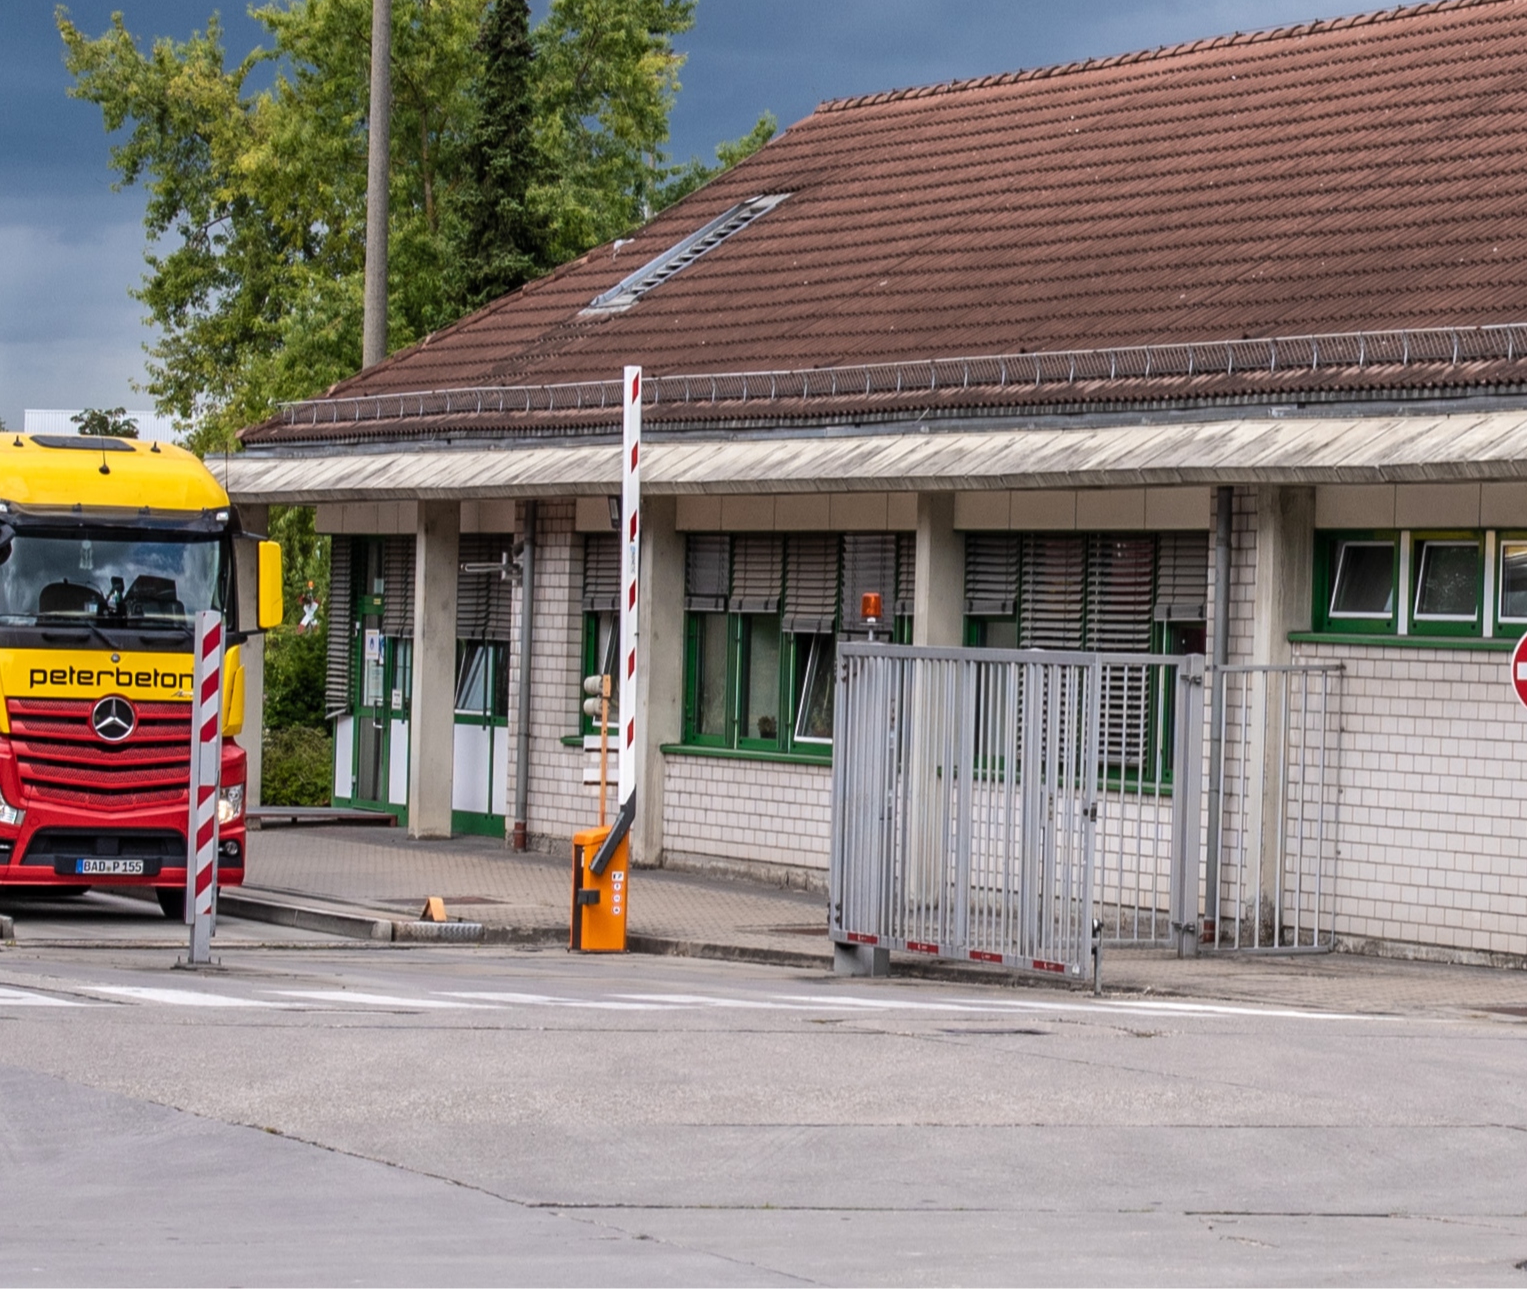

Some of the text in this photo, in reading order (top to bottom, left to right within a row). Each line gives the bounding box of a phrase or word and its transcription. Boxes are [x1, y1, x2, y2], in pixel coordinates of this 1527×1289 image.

[29, 665, 194, 689] peterbeton
[83, 860, 142, 873] BAD P 155
